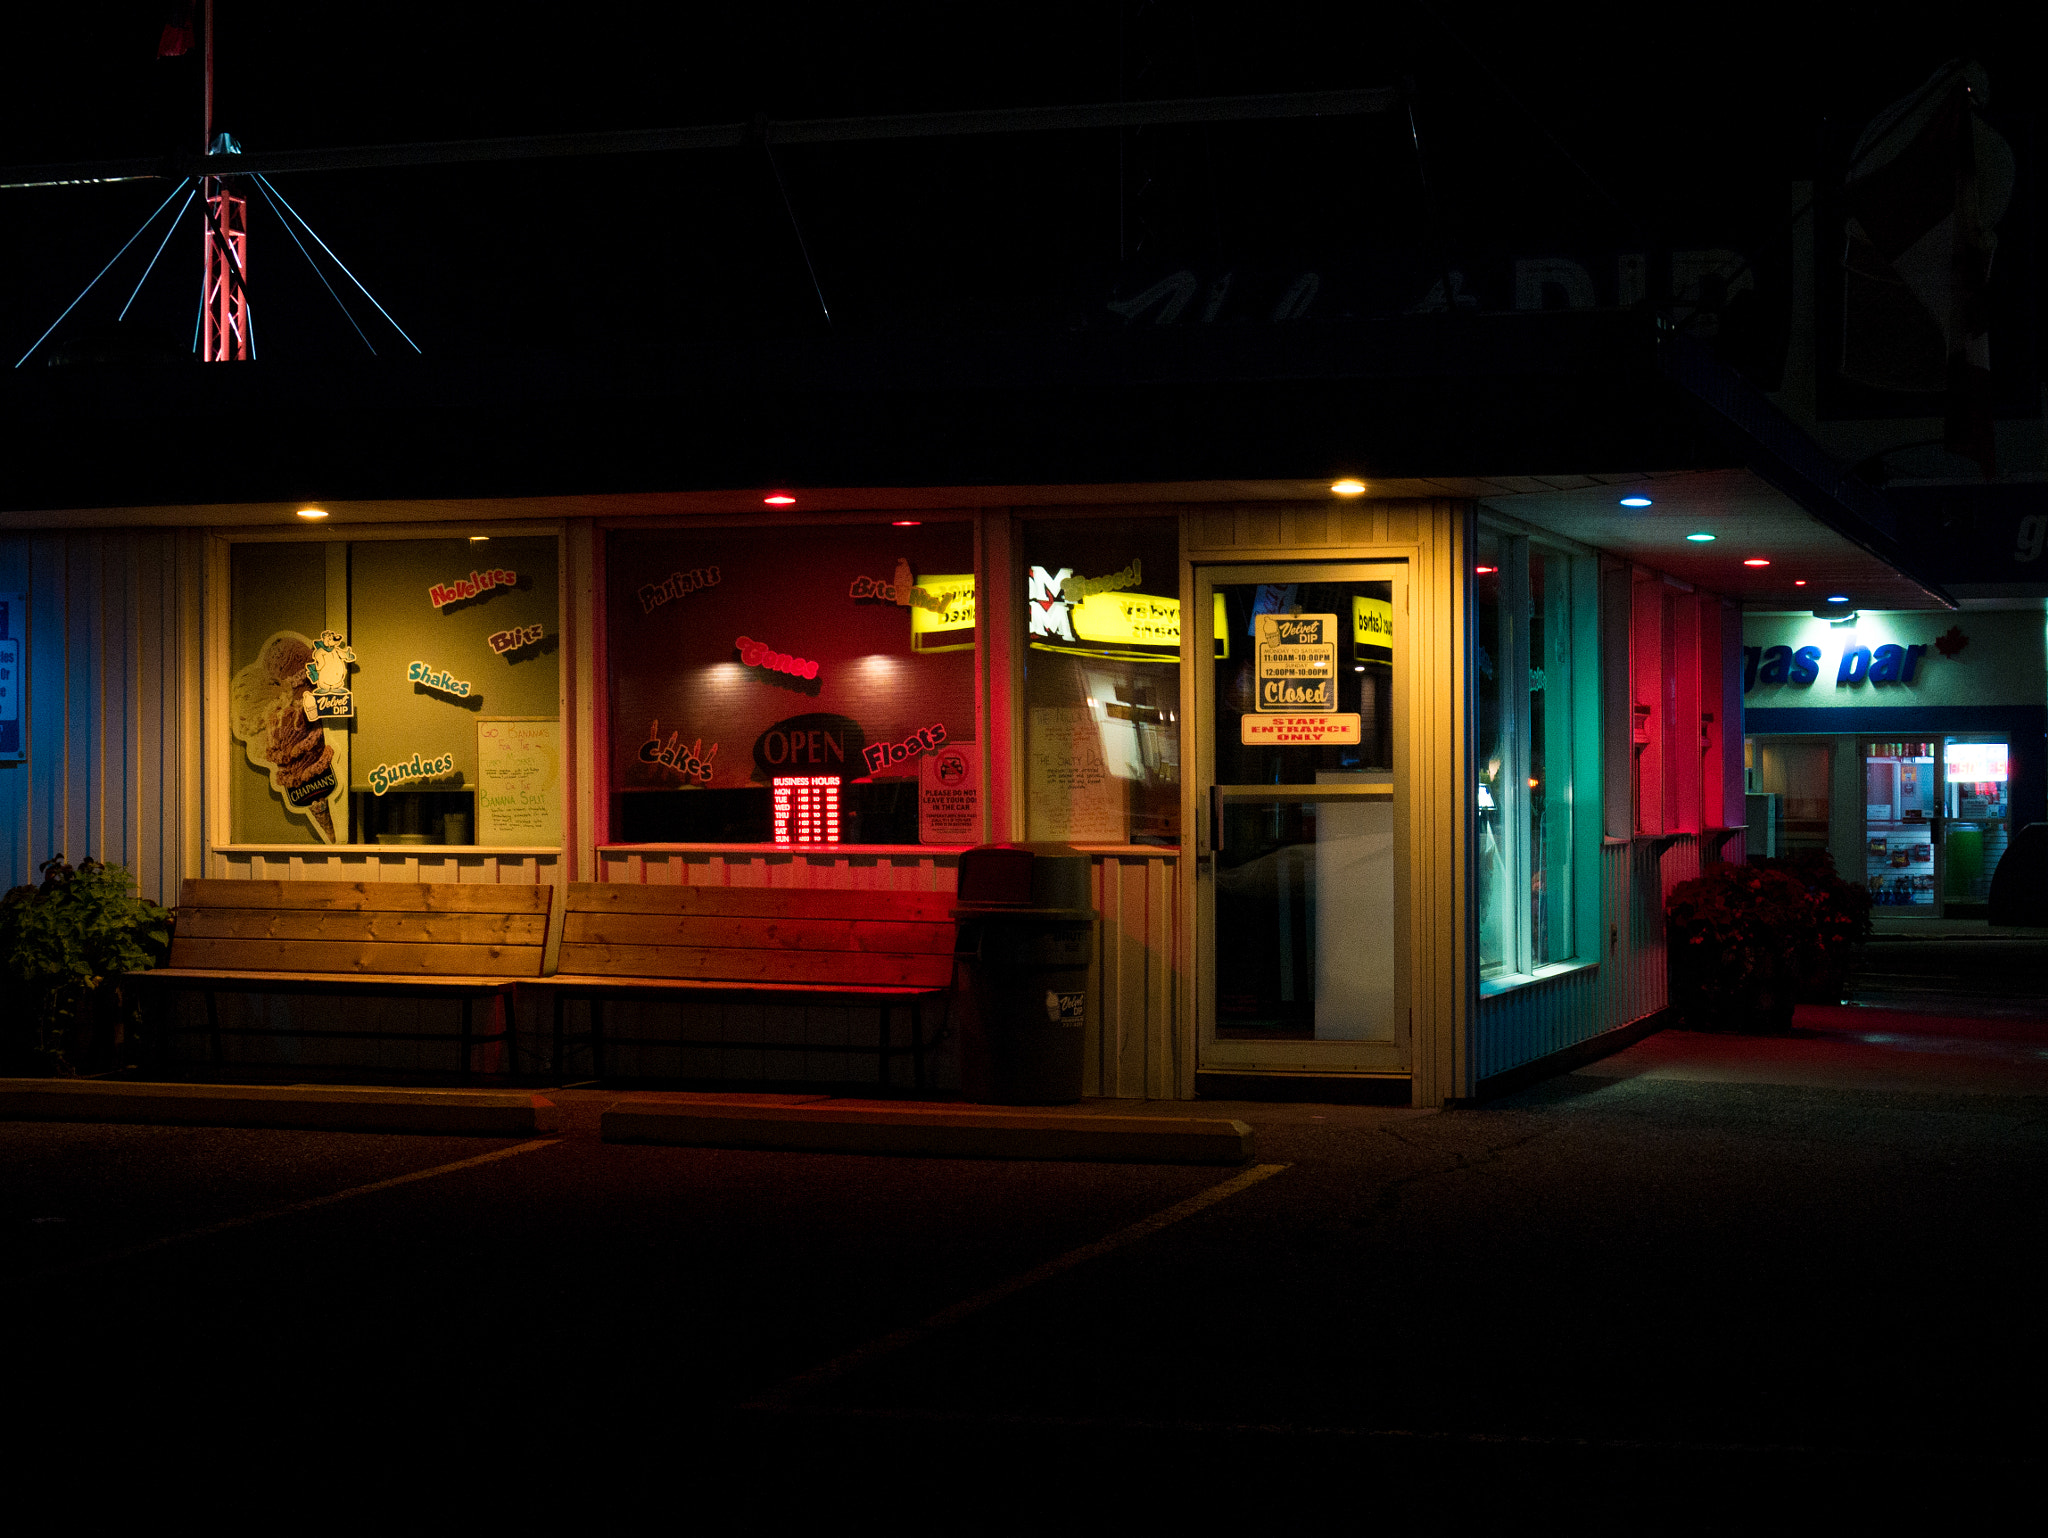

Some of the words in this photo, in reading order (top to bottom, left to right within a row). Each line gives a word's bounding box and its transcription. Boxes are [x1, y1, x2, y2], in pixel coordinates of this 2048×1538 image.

[429, 568, 516, 608] Novelties
[638, 565, 721, 614] Parfaits
[849, 575, 897, 601] Bite
[488, 624, 543, 654] Blitz
[1279, 621, 1320, 638] Velvet
[1299, 633, 1318, 644] DIP
[1837, 632, 1927, 684] bar
[407, 660, 471, 698] Shakes
[1264, 680, 1329, 703] Closed
[317, 695, 349, 711] Velvet
[333, 706, 349, 715] DIP
[638, 737, 714, 782] Cakes
[764, 730, 844, 764] OPEN
[862, 723, 947, 774] Floats
[290, 774, 335, 802] CHAPMAN'S
[369, 753, 454, 796] Sundaes
[773, 777, 809, 786] BUSINESS
[811, 776, 840, 786] HOURS
